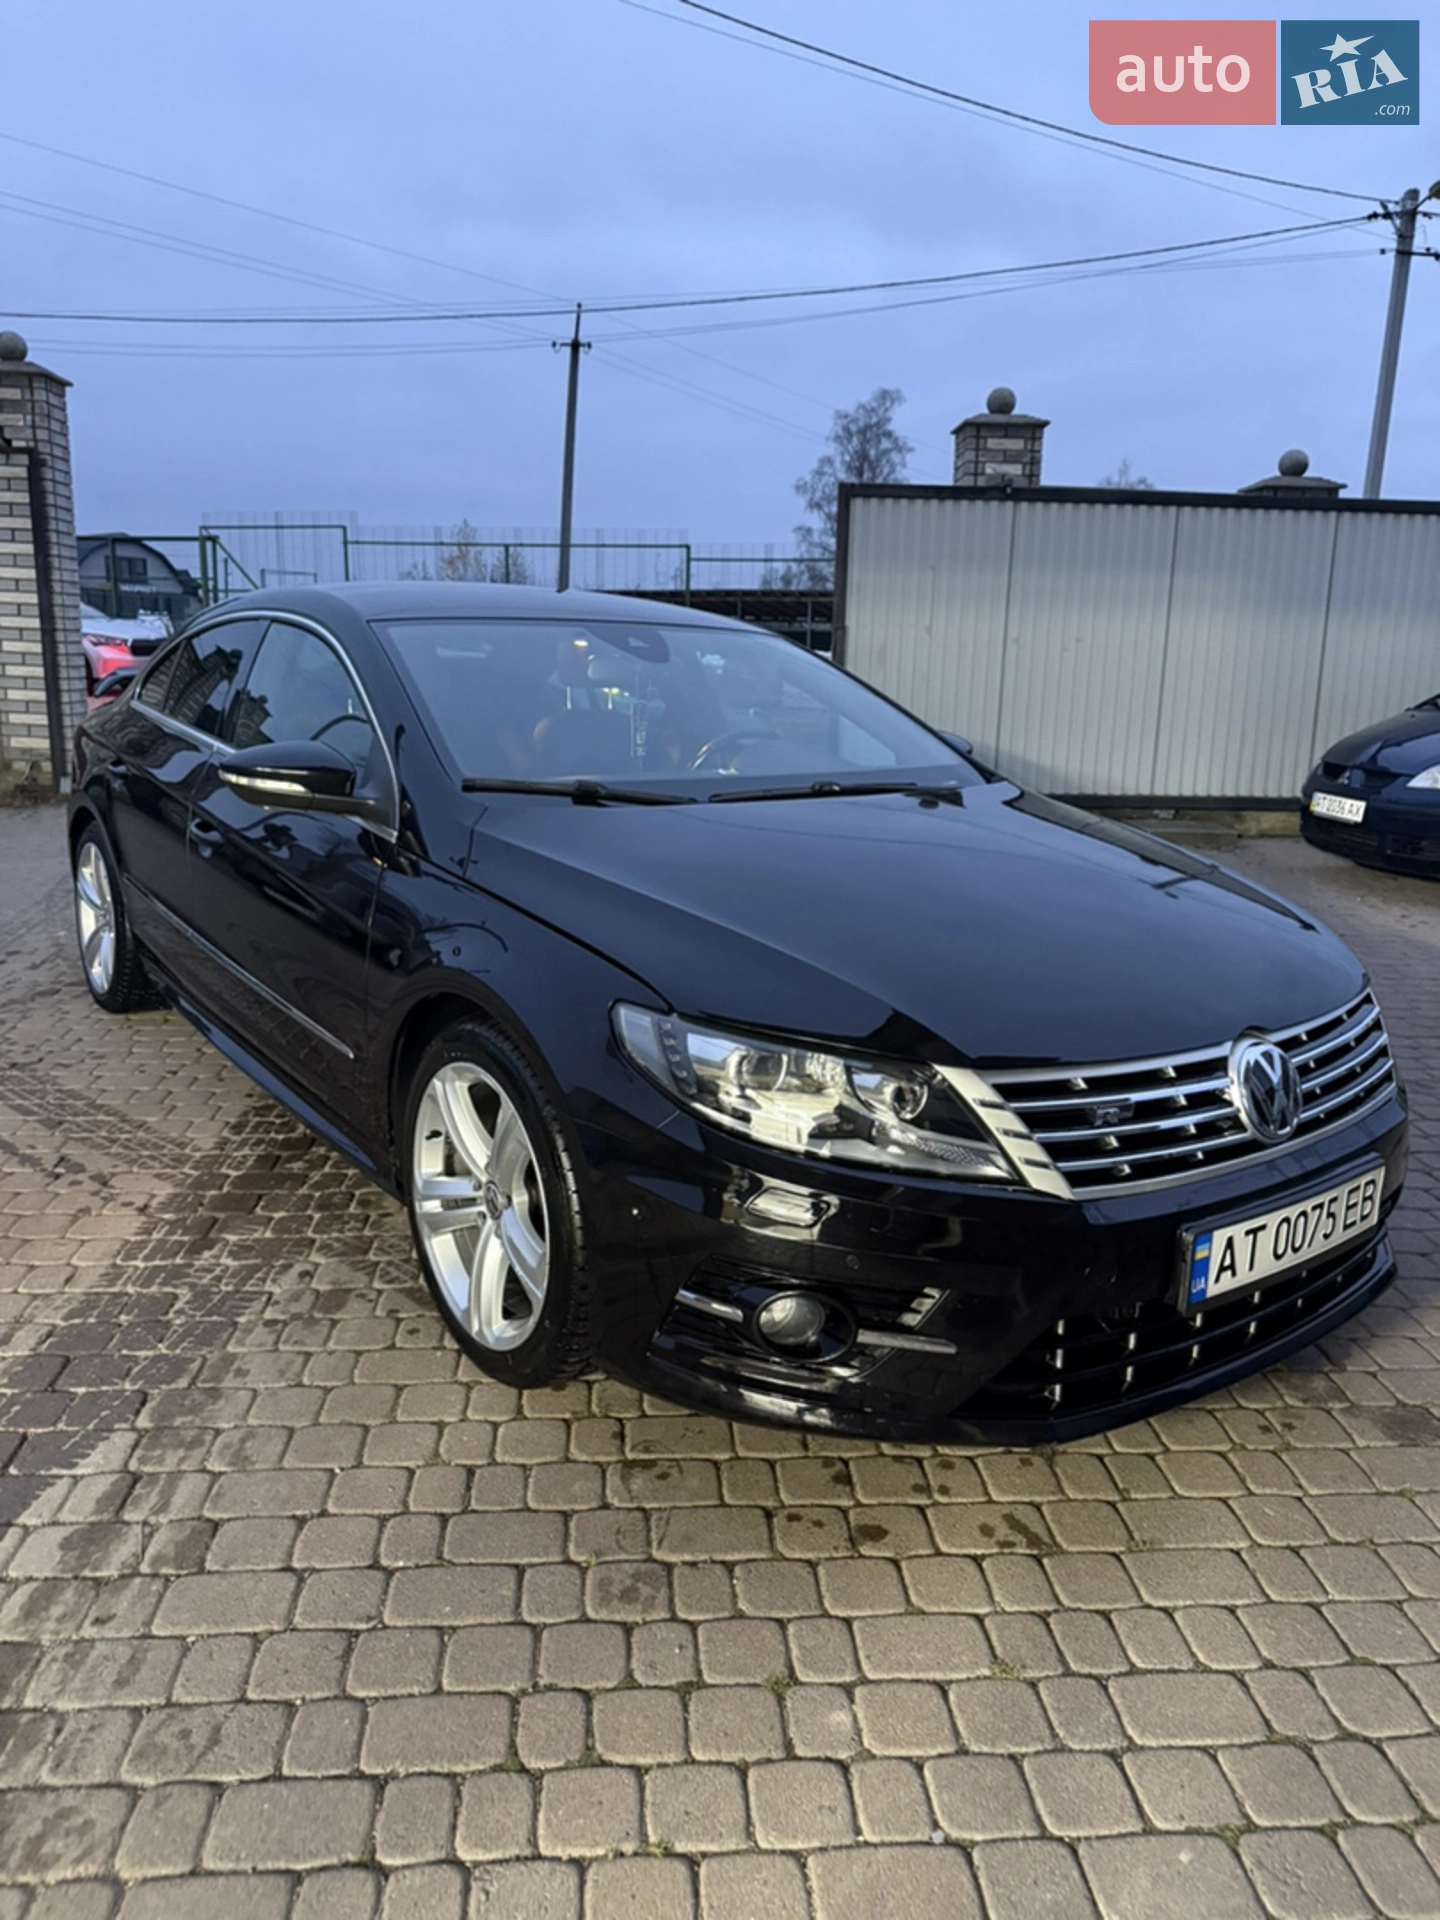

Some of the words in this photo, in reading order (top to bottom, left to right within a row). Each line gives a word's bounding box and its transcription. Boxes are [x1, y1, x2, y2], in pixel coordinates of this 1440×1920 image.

[1214, 1223, 1267, 1284] AT
[1273, 1197, 1338, 1261] 0075
[1342, 1178, 1376, 1232] EB
[1191, 1276, 1206, 1293] UA
